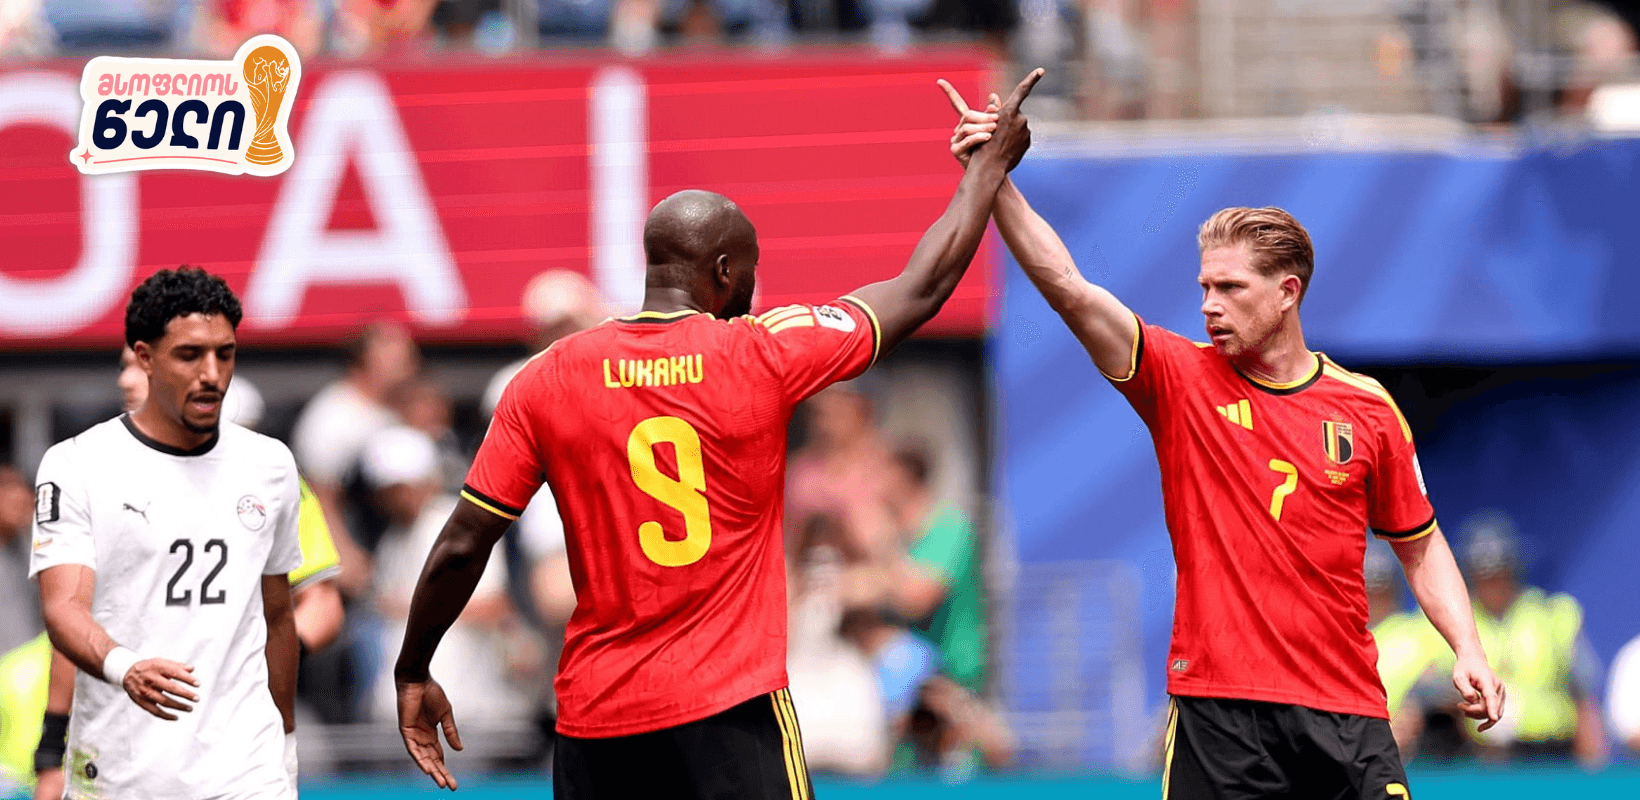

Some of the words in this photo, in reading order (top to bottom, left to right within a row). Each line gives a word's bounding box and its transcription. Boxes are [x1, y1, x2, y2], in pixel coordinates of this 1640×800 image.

[602, 353, 704, 389] LUKAKU
[627, 416, 712, 567] 9
[1268, 458, 1299, 521] 7
[165, 538, 228, 607] 22
